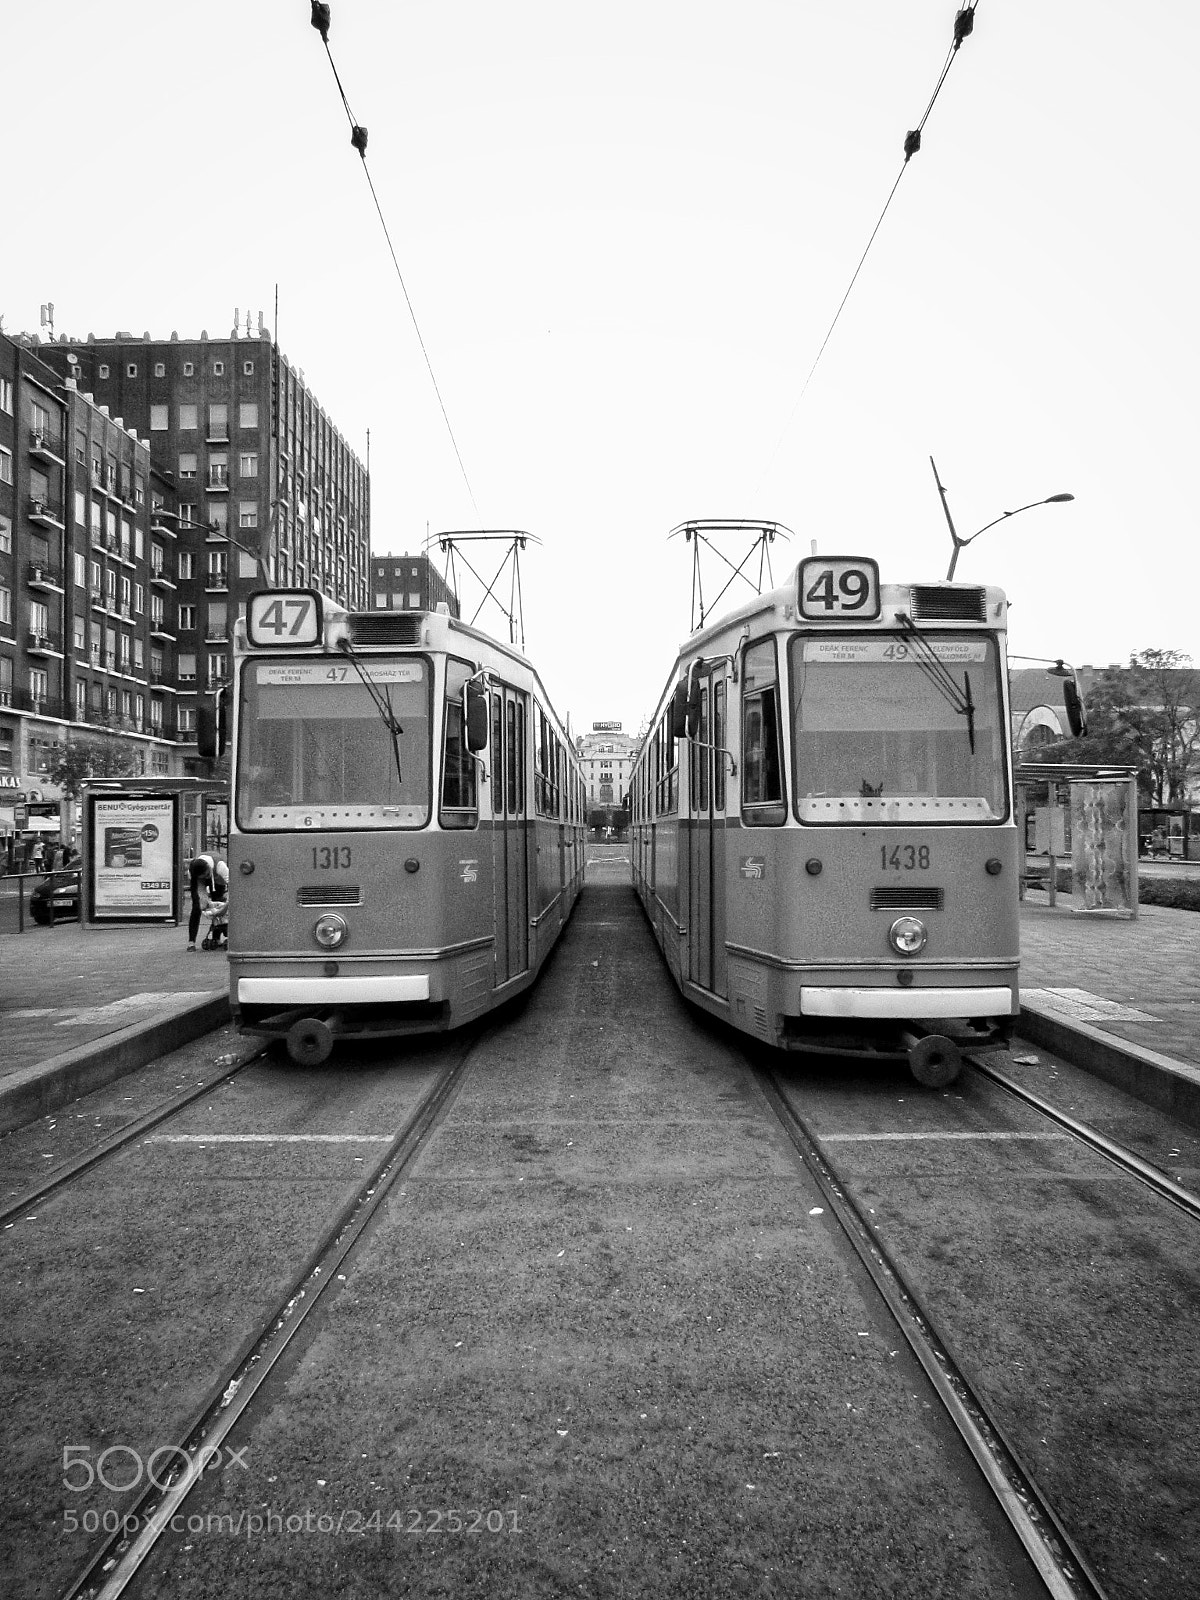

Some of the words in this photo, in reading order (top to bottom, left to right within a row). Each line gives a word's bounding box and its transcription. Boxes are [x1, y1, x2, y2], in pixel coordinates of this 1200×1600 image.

[806, 569, 870, 611] 49
[258, 600, 311, 636] 47
[883, 644, 909, 660] 49
[326, 667, 349, 682] 47
[304, 816, 313, 827] 6
[312, 846, 351, 870] 1313
[880, 845, 931, 871] 1438
